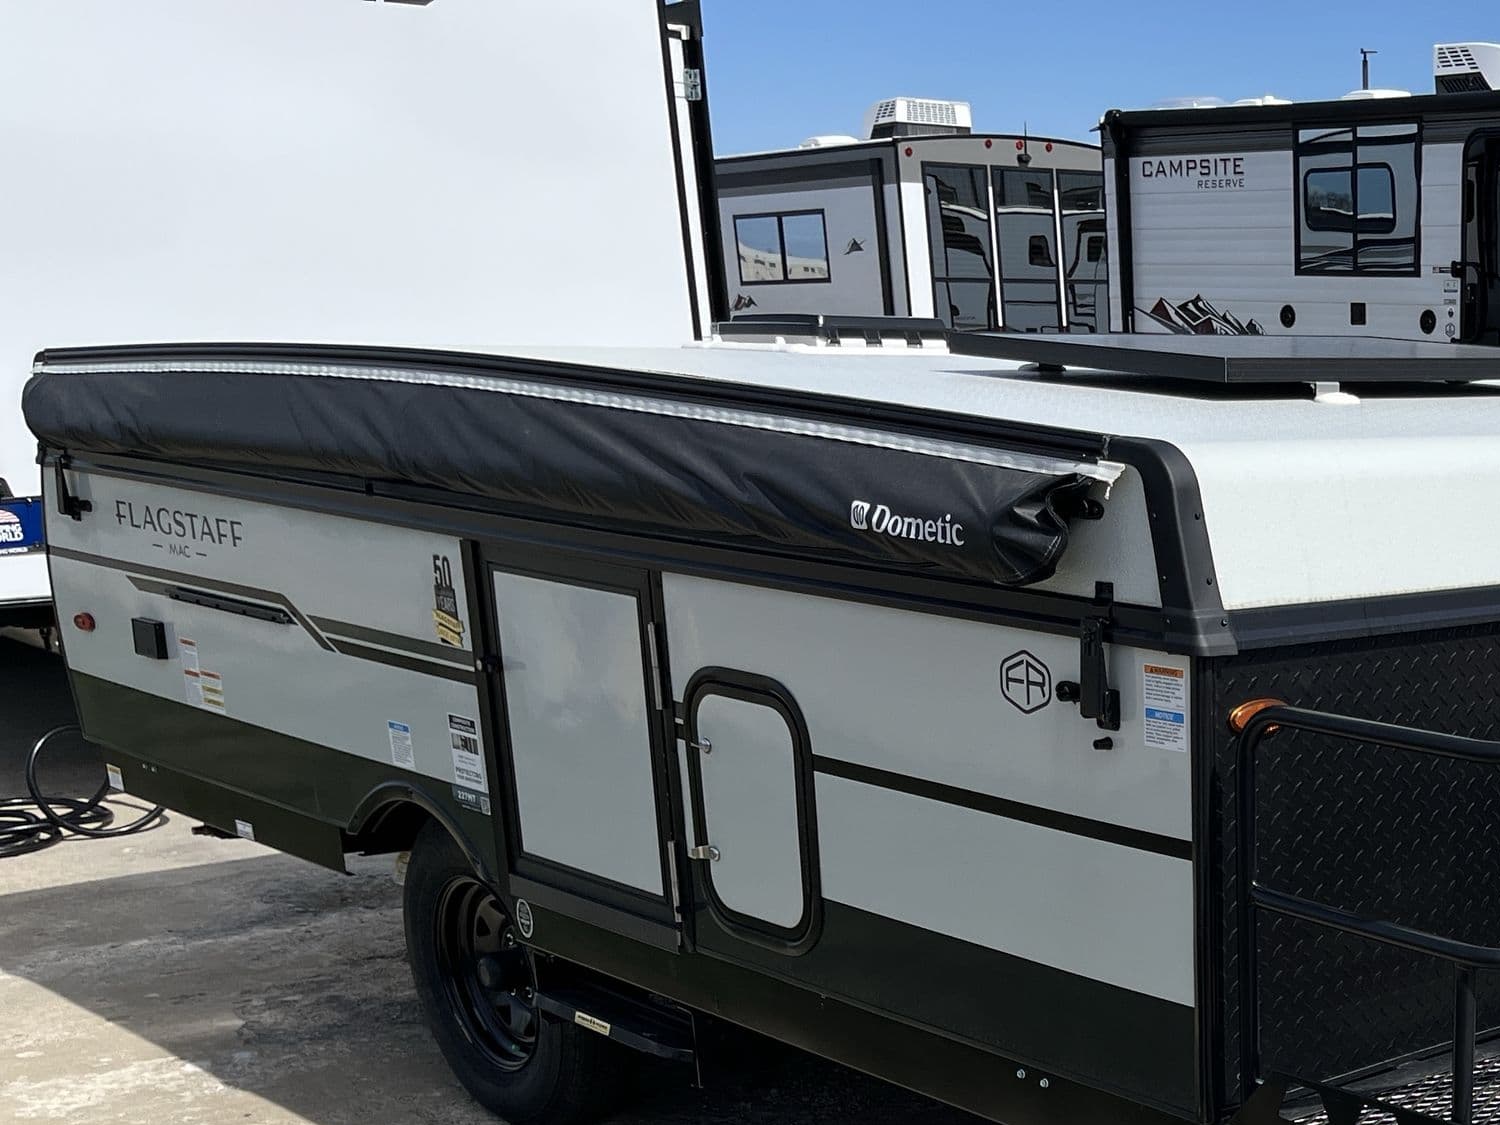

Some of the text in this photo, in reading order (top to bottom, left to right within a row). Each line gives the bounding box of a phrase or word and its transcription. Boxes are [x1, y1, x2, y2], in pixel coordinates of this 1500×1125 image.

[1142, 157, 1244, 178] CAMPSITE
[1197, 179, 1245, 190] RESERVE
[115, 499, 243, 548] FLAGSTAFF
[871, 504, 966, 547] Dometic
[169, 543, 192, 558] MAC
[432, 553, 454, 589] 50
